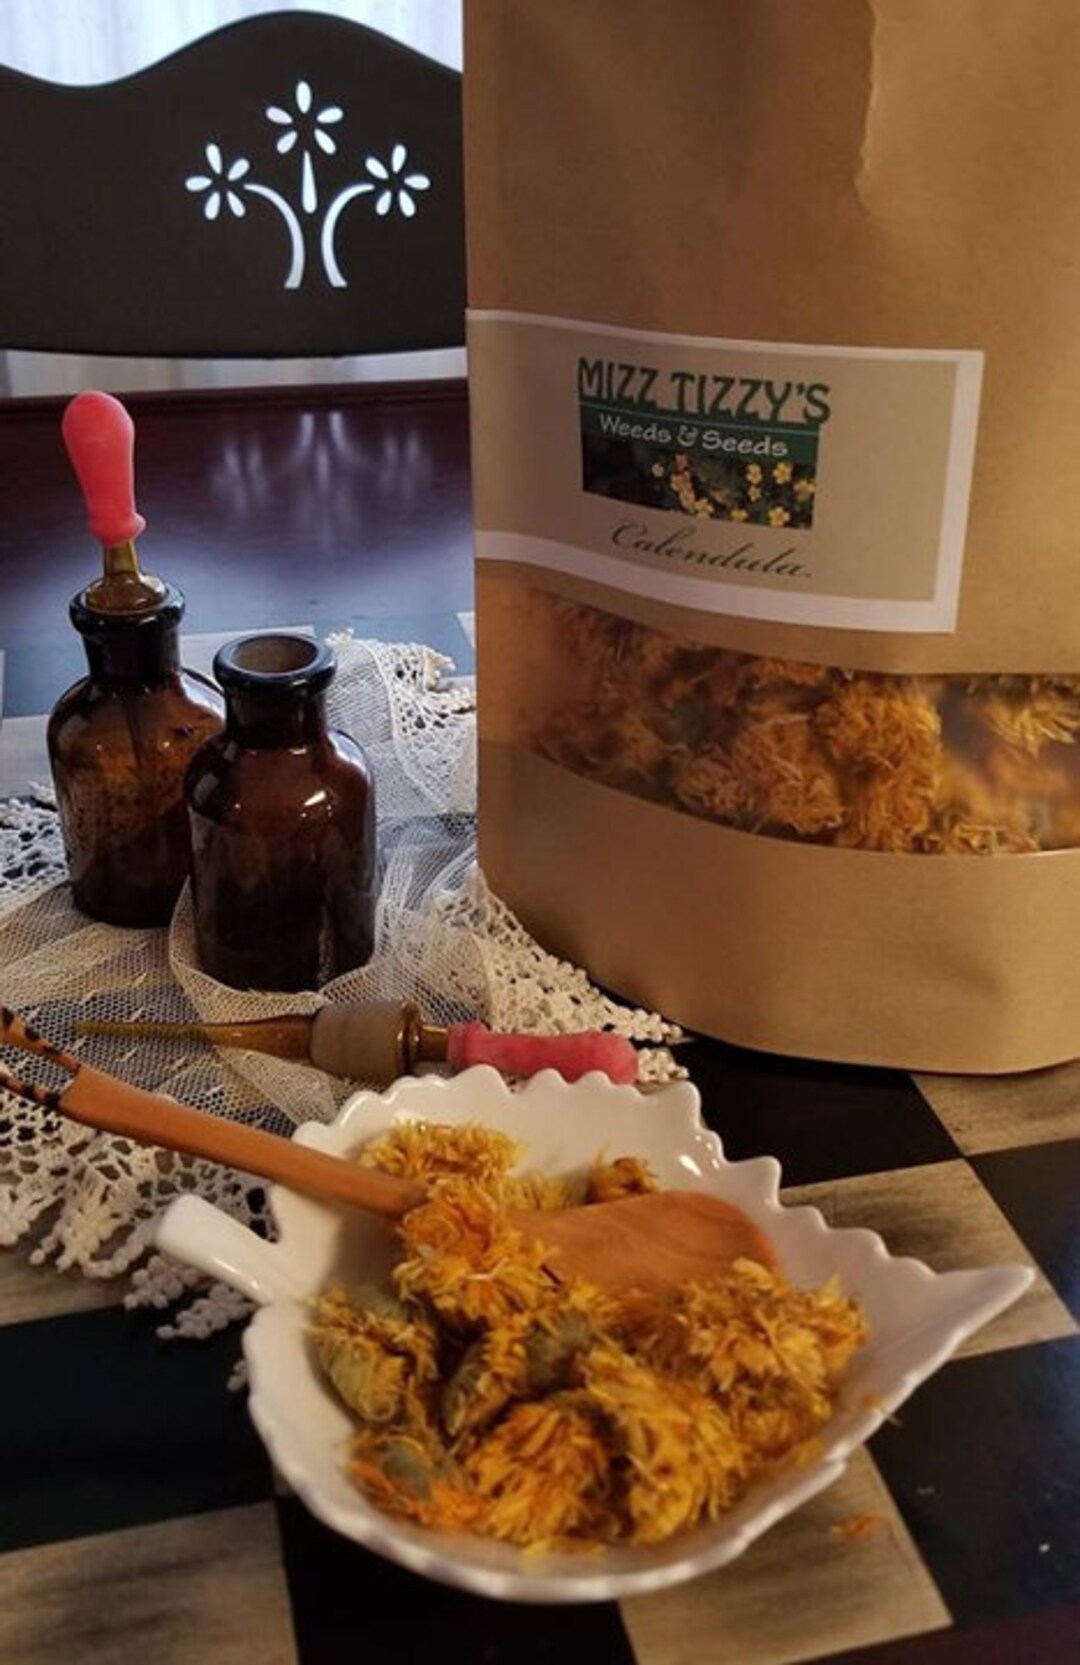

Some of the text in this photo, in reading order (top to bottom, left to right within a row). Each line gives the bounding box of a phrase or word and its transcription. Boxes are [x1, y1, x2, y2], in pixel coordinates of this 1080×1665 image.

[578, 356, 832, 424] MIZZ TIZZY'S
[600, 413, 788, 457] Weeds & Seeds
